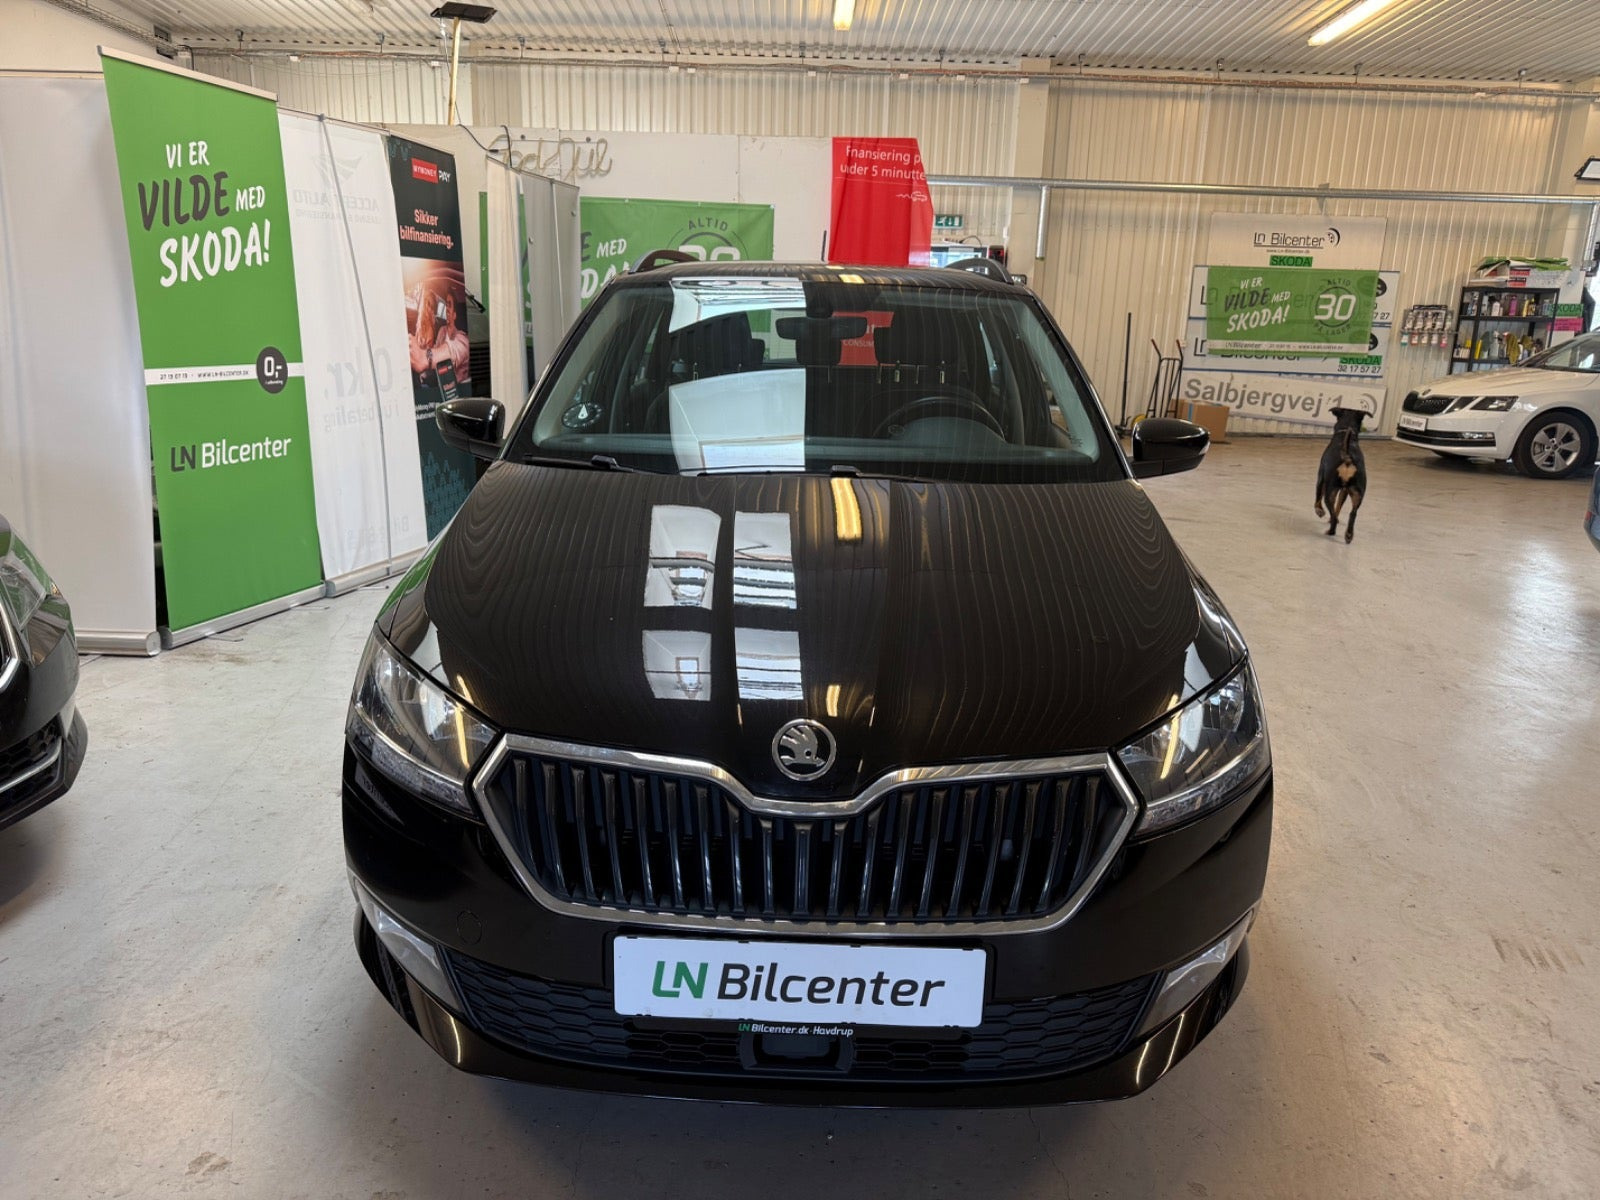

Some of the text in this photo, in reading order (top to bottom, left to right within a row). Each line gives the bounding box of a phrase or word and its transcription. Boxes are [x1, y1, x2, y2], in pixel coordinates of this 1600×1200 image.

[165, 140, 210, 168] VI ER
[846, 145, 910, 165] Fnansiering
[872, 165, 878, 176] 5
[138, 171, 266, 231] VILDE MED
[414, 208, 439, 226] Sikker
[688, 217, 728, 232] ALTID
[596, 238, 627, 258] MED
[1271, 232, 1325, 247] Bilcenter
[159, 218, 271, 288] SKODA!
[1271, 256, 1312, 267] SKODA
[1240, 276, 1263, 290] VI ER
[1327, 277, 1350, 286] ALTID
[1225, 287, 1270, 312] VILDE
[1271, 291, 1291, 303] MED
[1313, 293, 1356, 320] 30
[1226, 304, 1290, 333] SKODA!
[1380, 312, 1390, 320] 27
[1338, 365, 1347, 373] 32
[1350, 365, 1358, 373] 17
[1360, 365, 1370, 373] 57
[1184, 378, 1323, 417] Salbjergvej
[170, 437, 291, 472] LN Bilcenter
[652, 960, 945, 1008] LN Bilcenter
[813, 1026, 854, 1038] Havdrup
